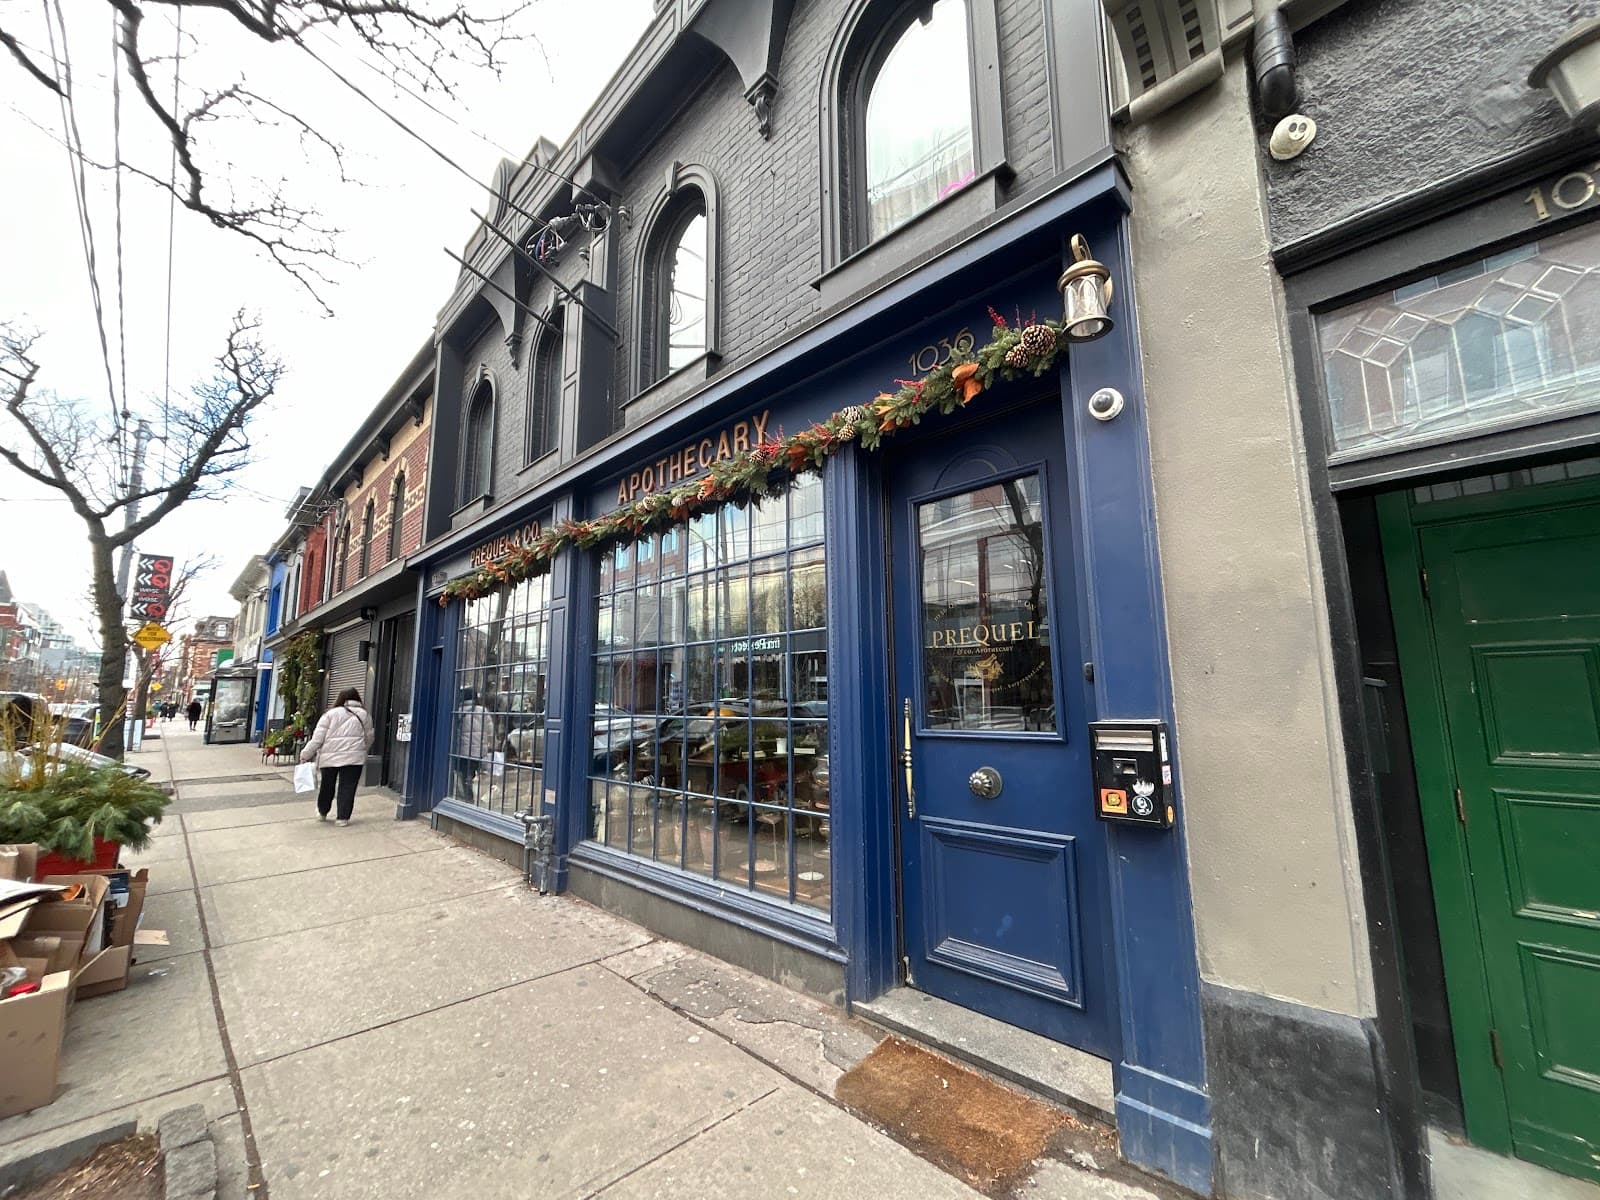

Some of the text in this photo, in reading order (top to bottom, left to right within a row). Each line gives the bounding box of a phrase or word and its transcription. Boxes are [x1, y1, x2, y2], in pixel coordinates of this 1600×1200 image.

[1524, 161, 1600, 220] 10
[617, 409, 770, 506] APOTHECARY
[470, 533, 511, 569] PREQUEL
[523, 520, 541, 545] CO.
[932, 621, 1041, 648] PREQUEL
